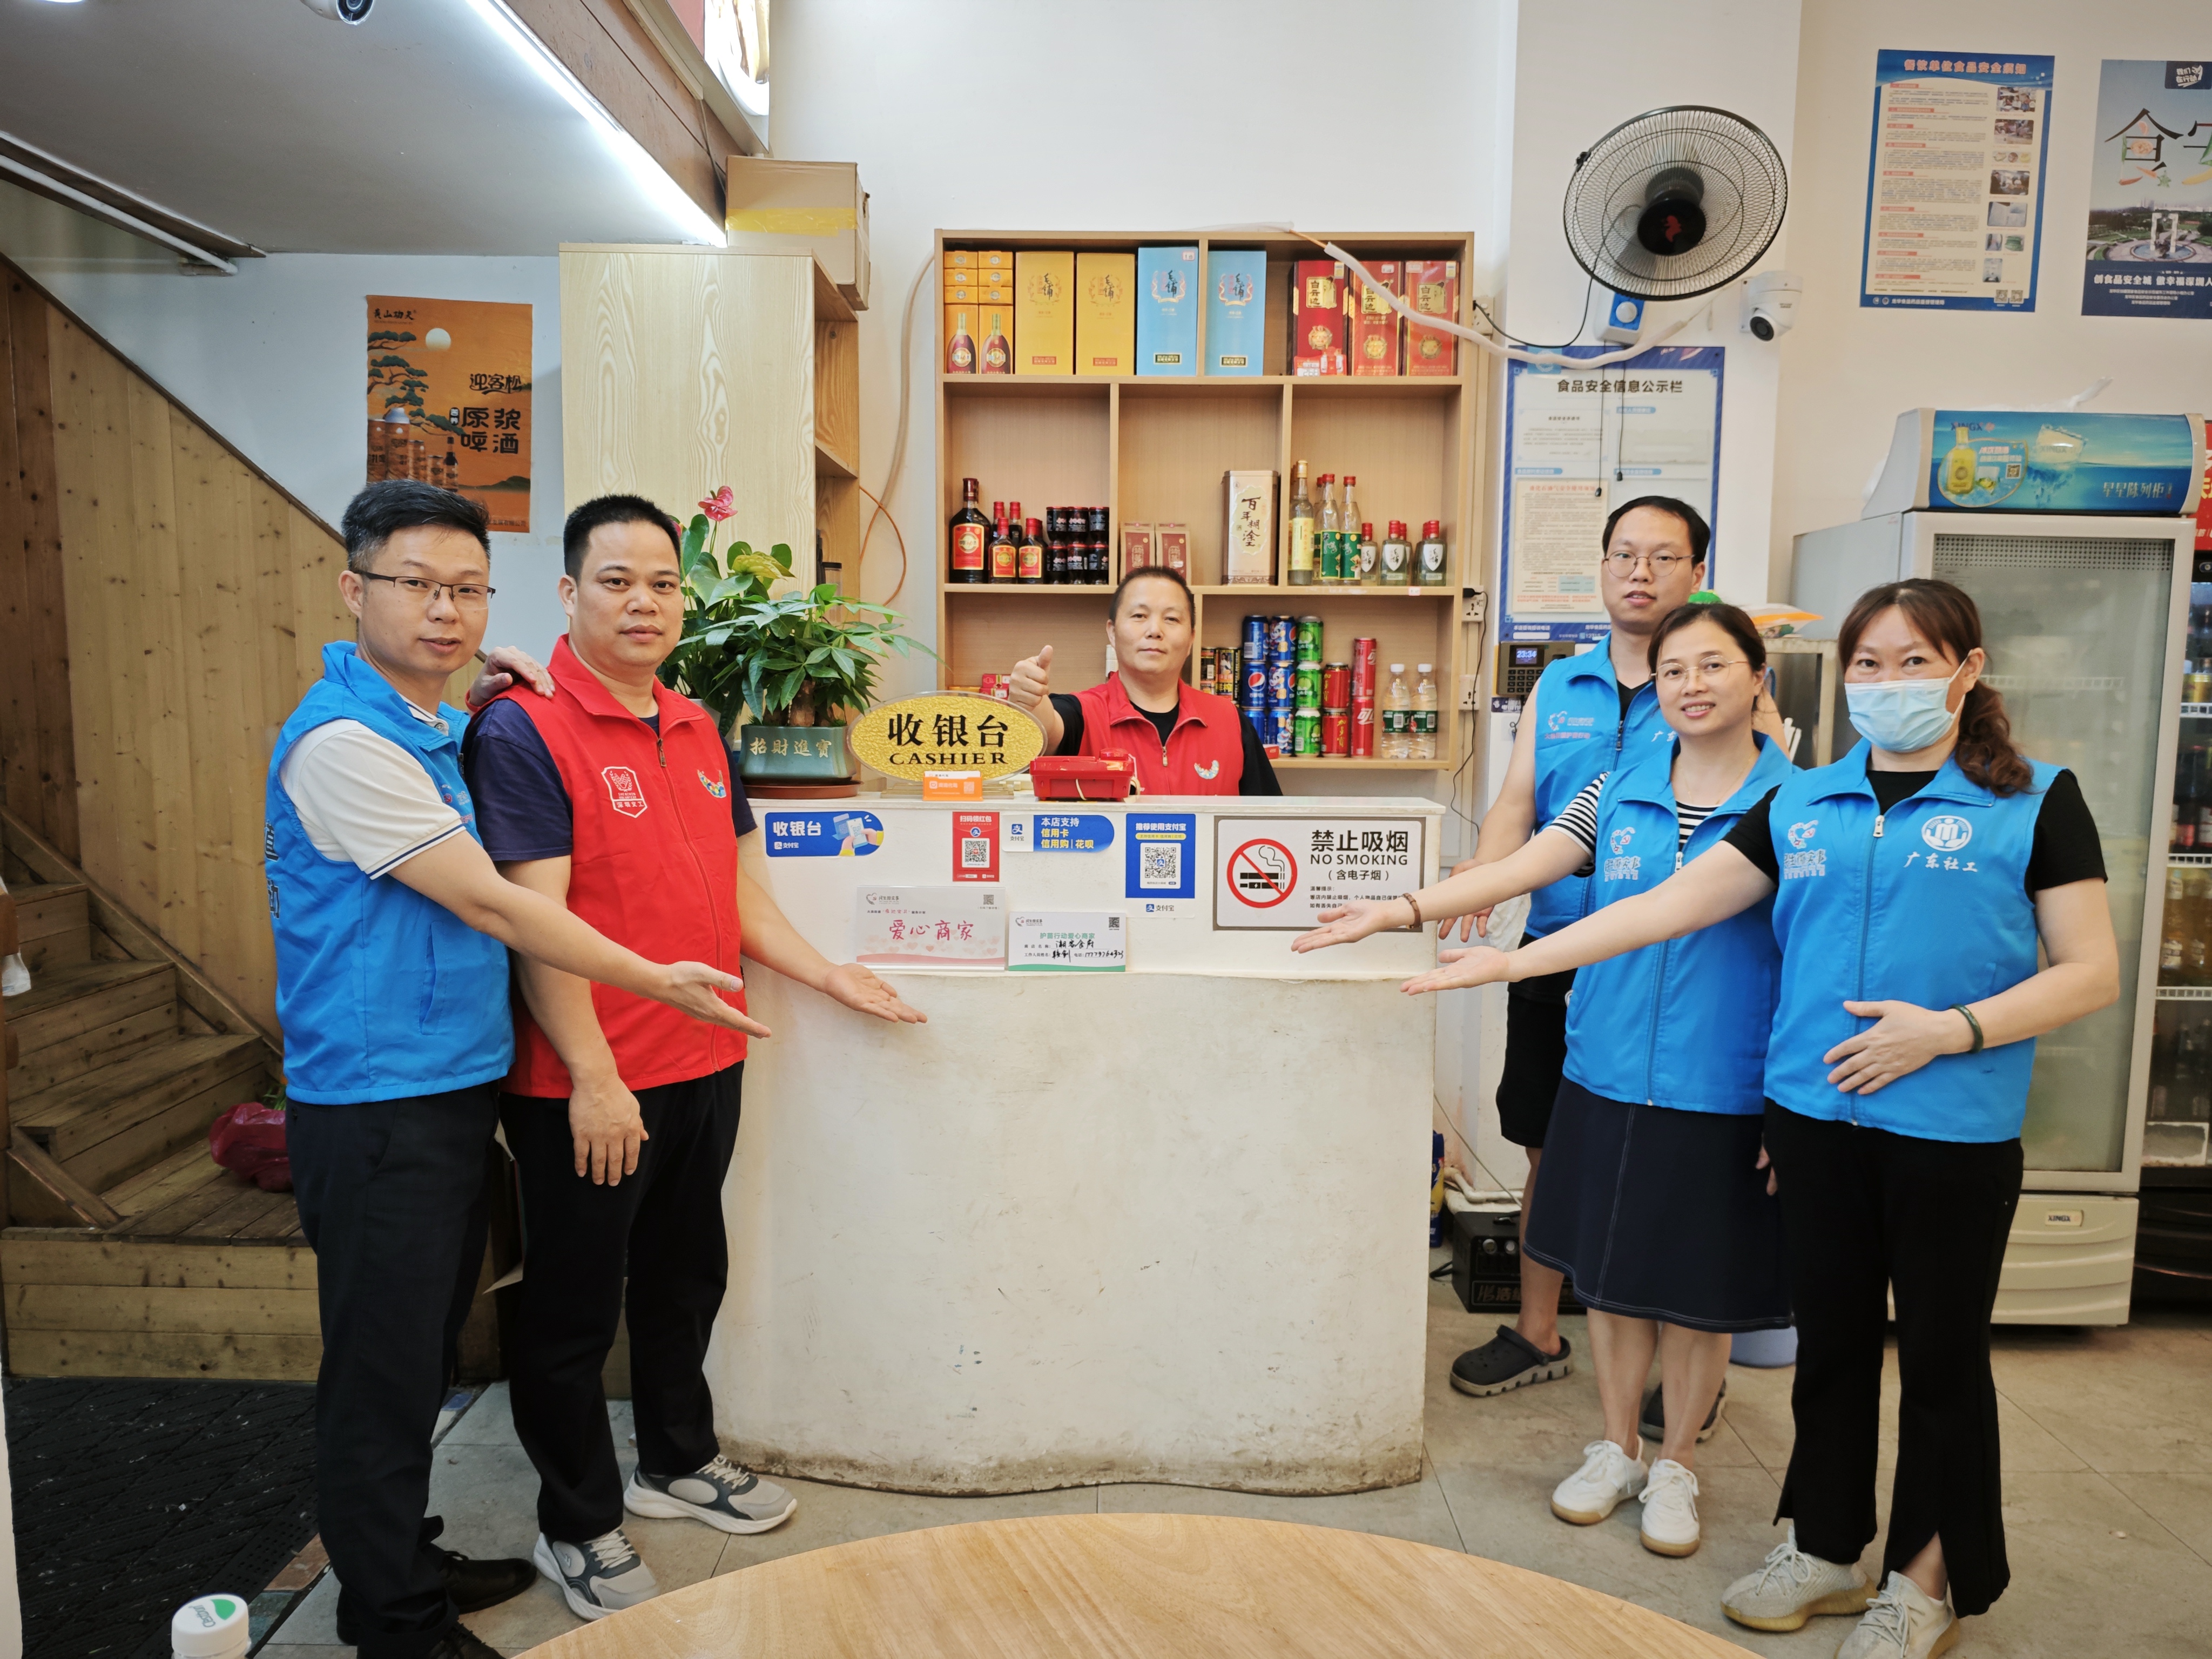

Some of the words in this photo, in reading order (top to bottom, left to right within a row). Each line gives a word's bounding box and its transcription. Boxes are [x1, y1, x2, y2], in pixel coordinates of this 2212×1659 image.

[1310, 280, 1320, 306] 白云边
[1420, 286, 1431, 311] 白云边
[469, 373, 522, 395] 迎客松
[1557, 379, 1683, 393] 食品安全信息公示栏
[462, 407, 521, 430] 原浆
[461, 431, 518, 454] 啤酒
[1241, 496, 1261, 547] 百年糊涂
[1516, 650, 1537, 658] 23:34
[888, 713, 1008, 747] 收银台
[750, 737, 832, 758] 招財進寶
[889, 752, 1009, 765] CASHIER
[773, 820, 821, 837] 收银台
[1041, 817, 1080, 827] 本店支持
[1135, 822, 1186, 831] 推荐使用支付宝
[1041, 828, 1069, 838] 信用卡
[1311, 830, 1408, 853] 禁止吸烟
[1311, 854, 1332, 865] NO
[1337, 854, 1407, 865] SMOKING
[1903, 851, 1978, 872] 广东社工
[889, 920, 974, 941] 爱心商家
